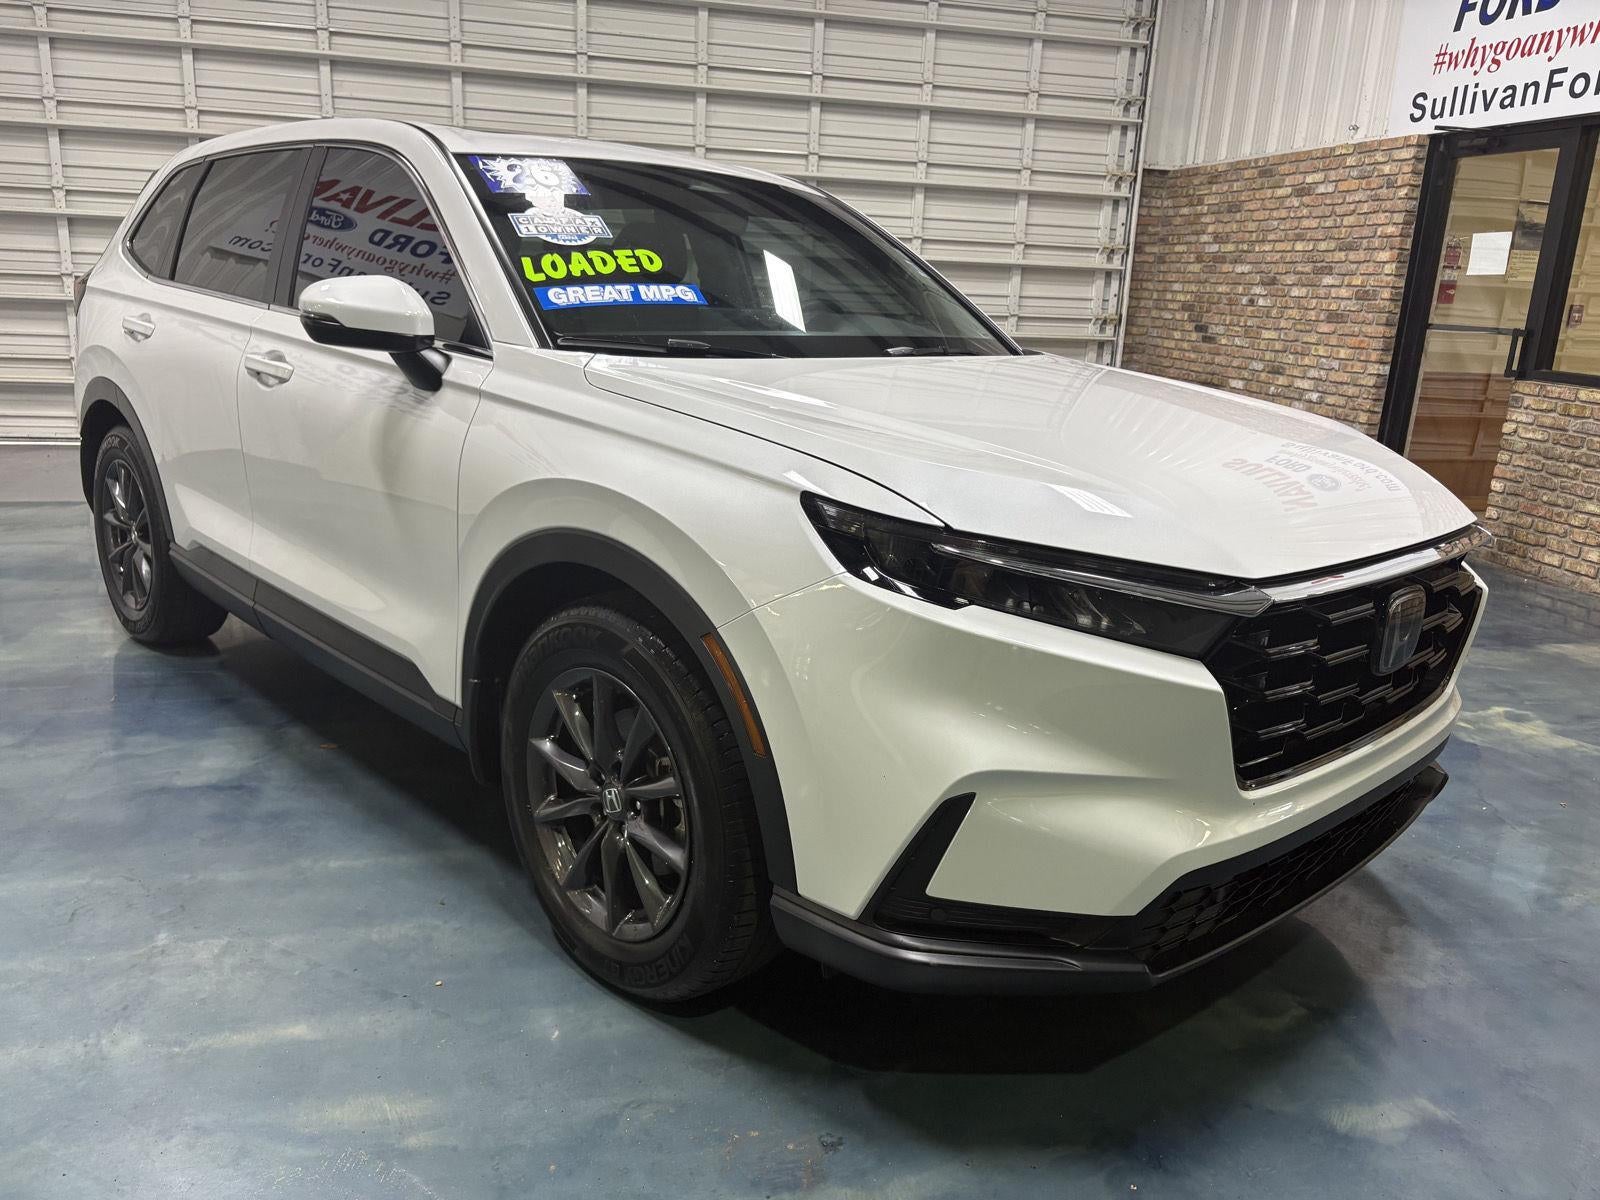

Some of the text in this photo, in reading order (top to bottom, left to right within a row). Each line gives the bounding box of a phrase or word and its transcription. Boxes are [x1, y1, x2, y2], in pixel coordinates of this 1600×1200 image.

[1453, 0, 1561, 32] FO
[521, 249, 663, 282] LOADED
[547, 285, 699, 305] GREAT MPG
